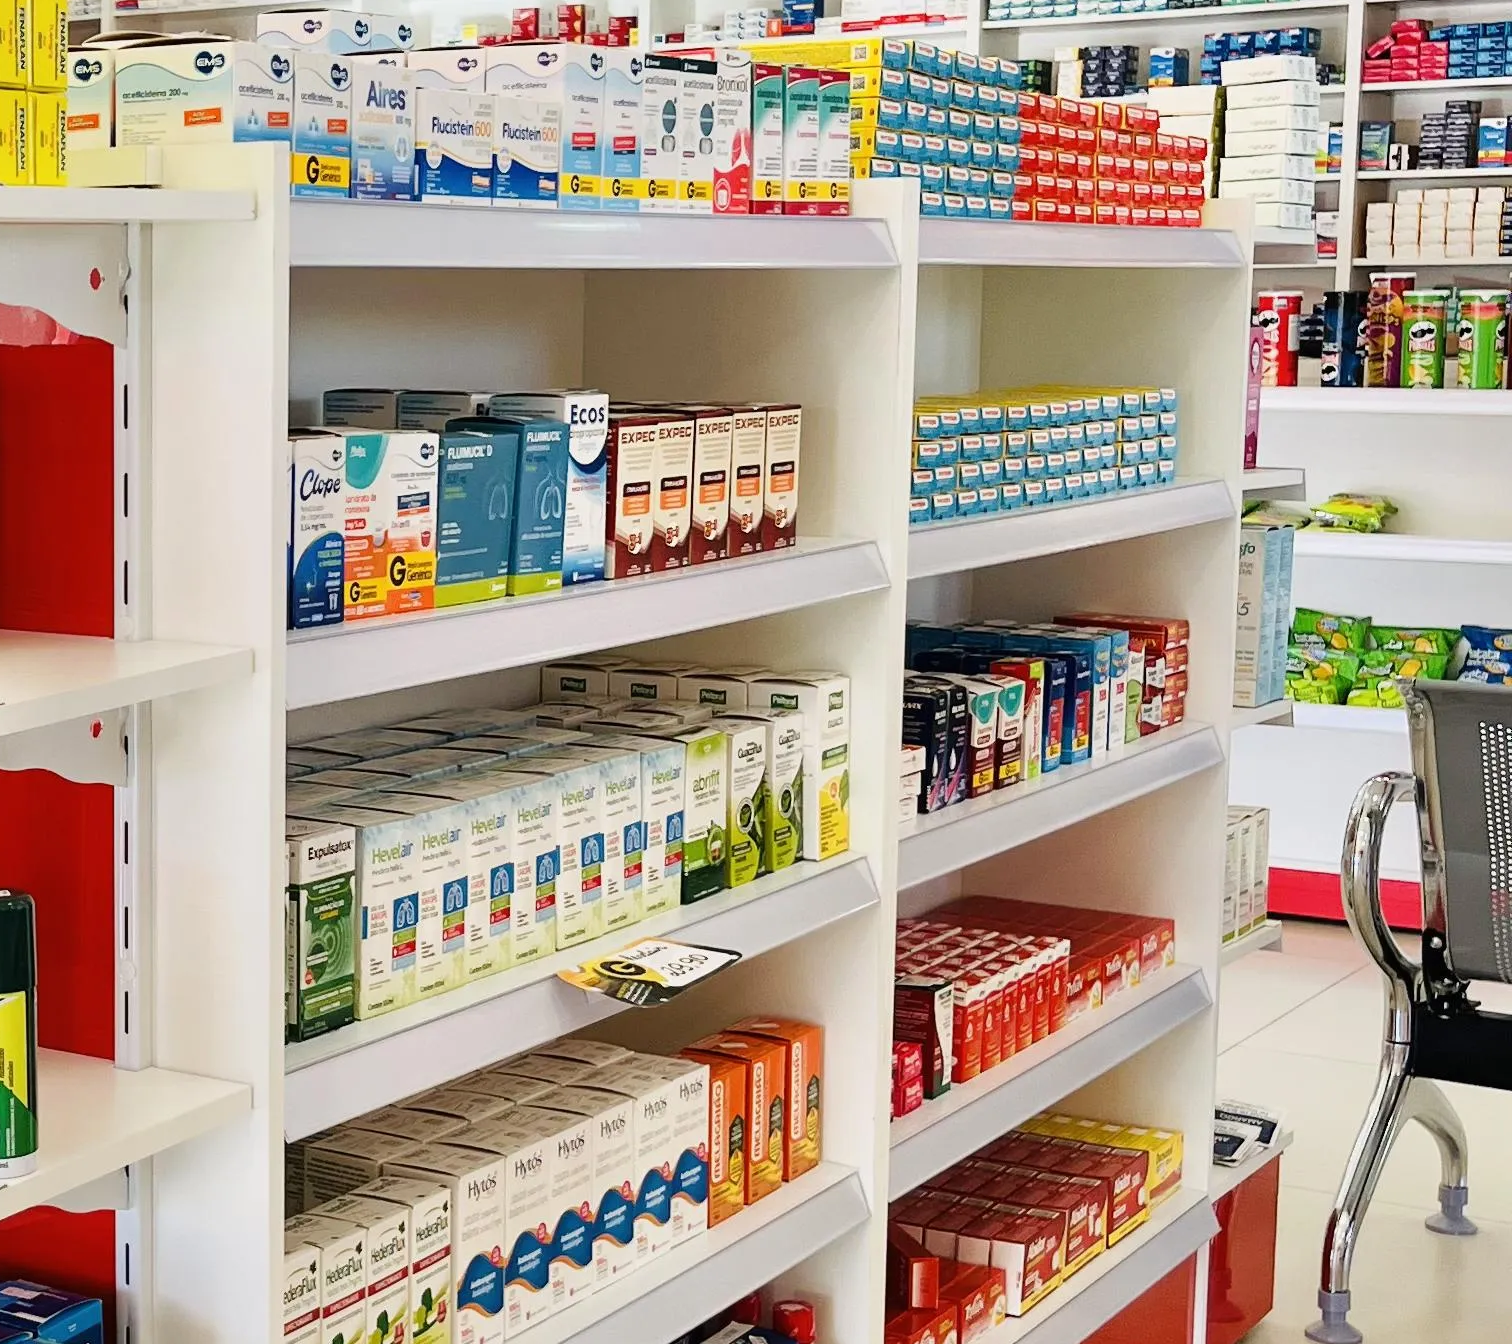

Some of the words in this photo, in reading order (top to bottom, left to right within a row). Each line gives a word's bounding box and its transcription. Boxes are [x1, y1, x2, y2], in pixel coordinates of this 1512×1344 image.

[75, 64, 101, 75] EMS
[196, 56, 224, 67] EMS
[367, 81, 406, 110] Aires
[432, 116, 474, 136] Flucistein
[475, 120, 491, 137] 600
[502, 123, 540, 140] Flucistein
[542, 127, 557, 142] 600
[306, 156, 319, 183] G
[571, 404, 605, 424] Ecos
[735, 417, 764, 429] EXPEC
[769, 414, 799, 427] EXPEC
[621, 431, 655, 444] EXPEC
[659, 427, 692, 439] EXPEC
[699, 422, 731, 435] EXPEC
[390, 556, 406, 586] G
[606, 775, 637, 796] Hevelair
[651, 766, 681, 785] Hevelair
[561, 784, 596, 806] Hevelair
[517, 803, 552, 824] Hevelair
[471, 814, 507, 836] Hevelair
[422, 828, 461, 850] Hevelair
[308, 840, 352, 860] Expulsatox
[371, 841, 413, 864] Hevelair
[284, 1278, 317, 1305] ederaFlux
